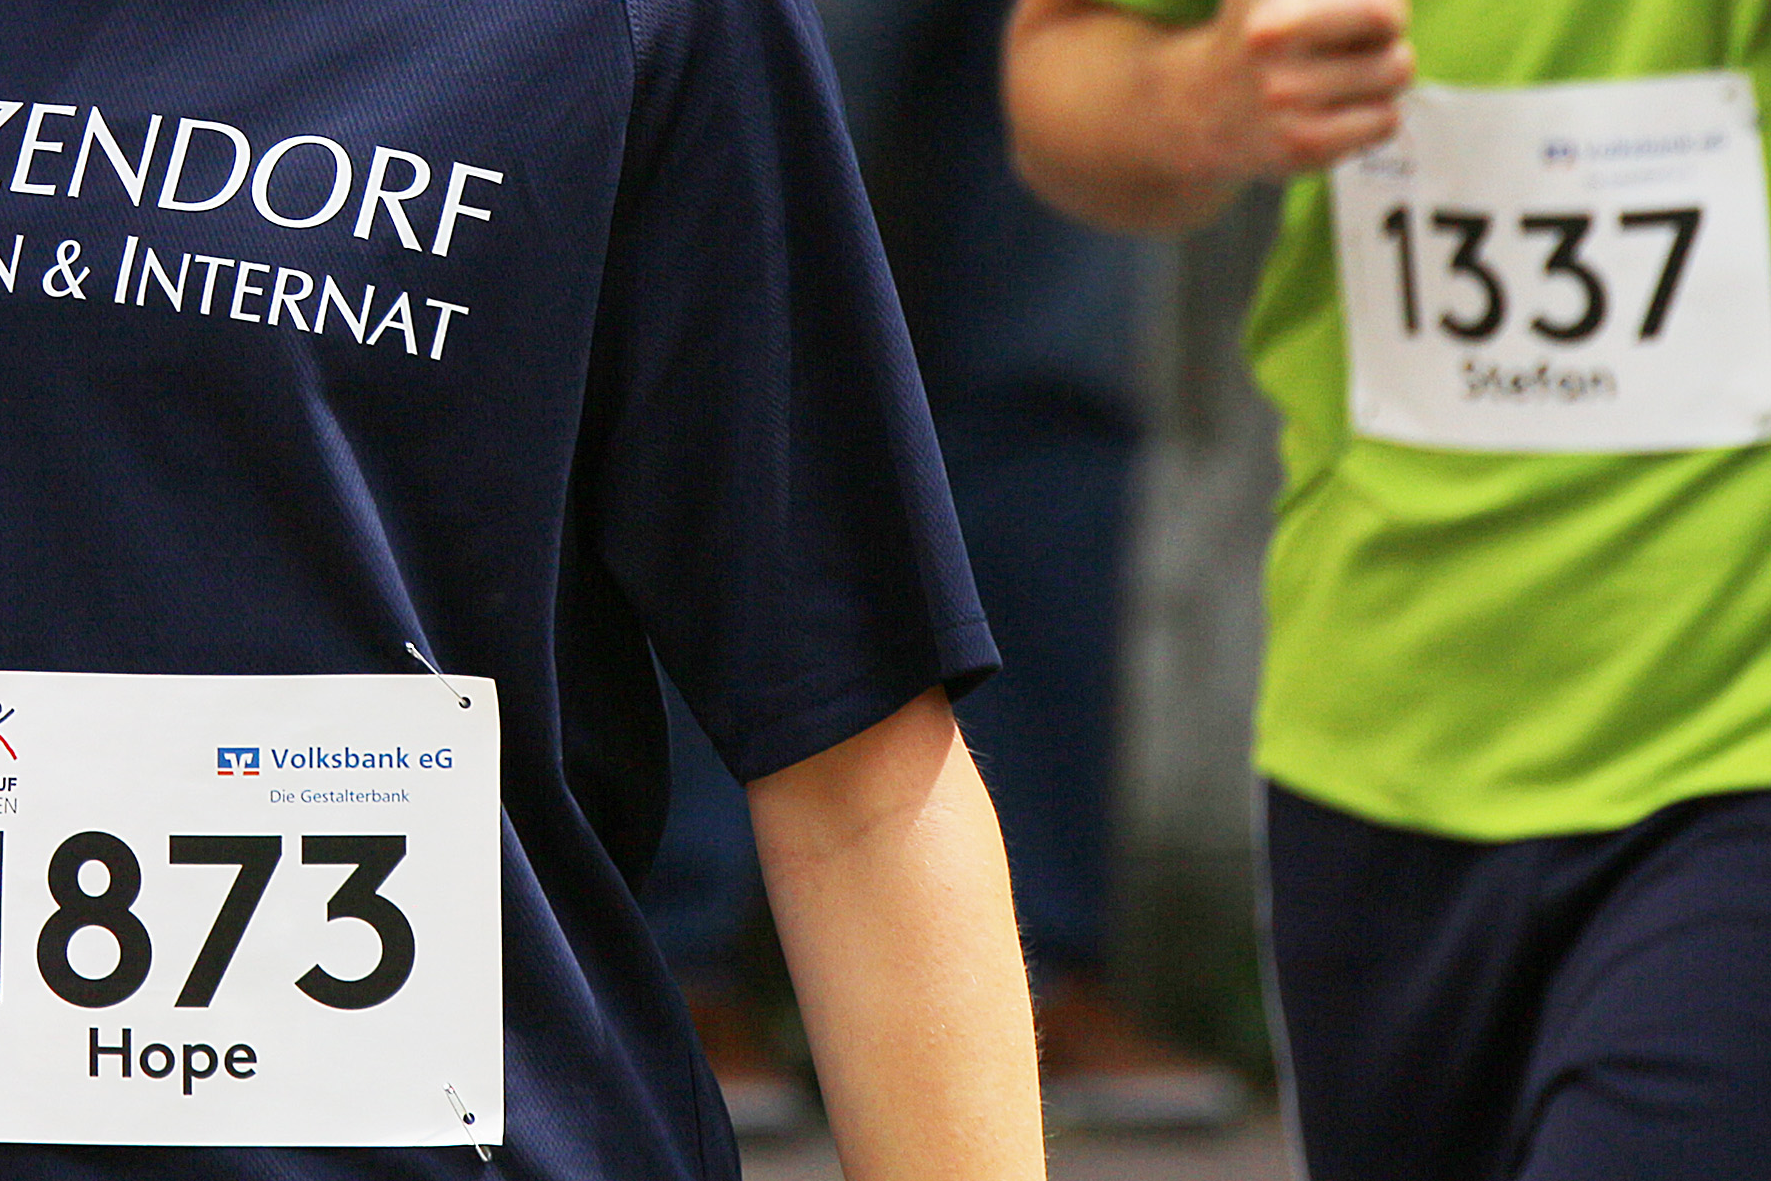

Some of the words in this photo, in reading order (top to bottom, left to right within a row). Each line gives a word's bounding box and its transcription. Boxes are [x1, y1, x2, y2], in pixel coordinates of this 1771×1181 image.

[42, 239, 91, 301] &
[114, 235, 470, 361] INTERNAT
[1381, 205, 1703, 345] 1337
[270, 746, 410, 769] Volksbank
[419, 748, 453, 769] eG
[269, 789, 295, 804] Die
[300, 789, 410, 804] Gestalterbank
[89, 1027, 258, 1096] Hope
